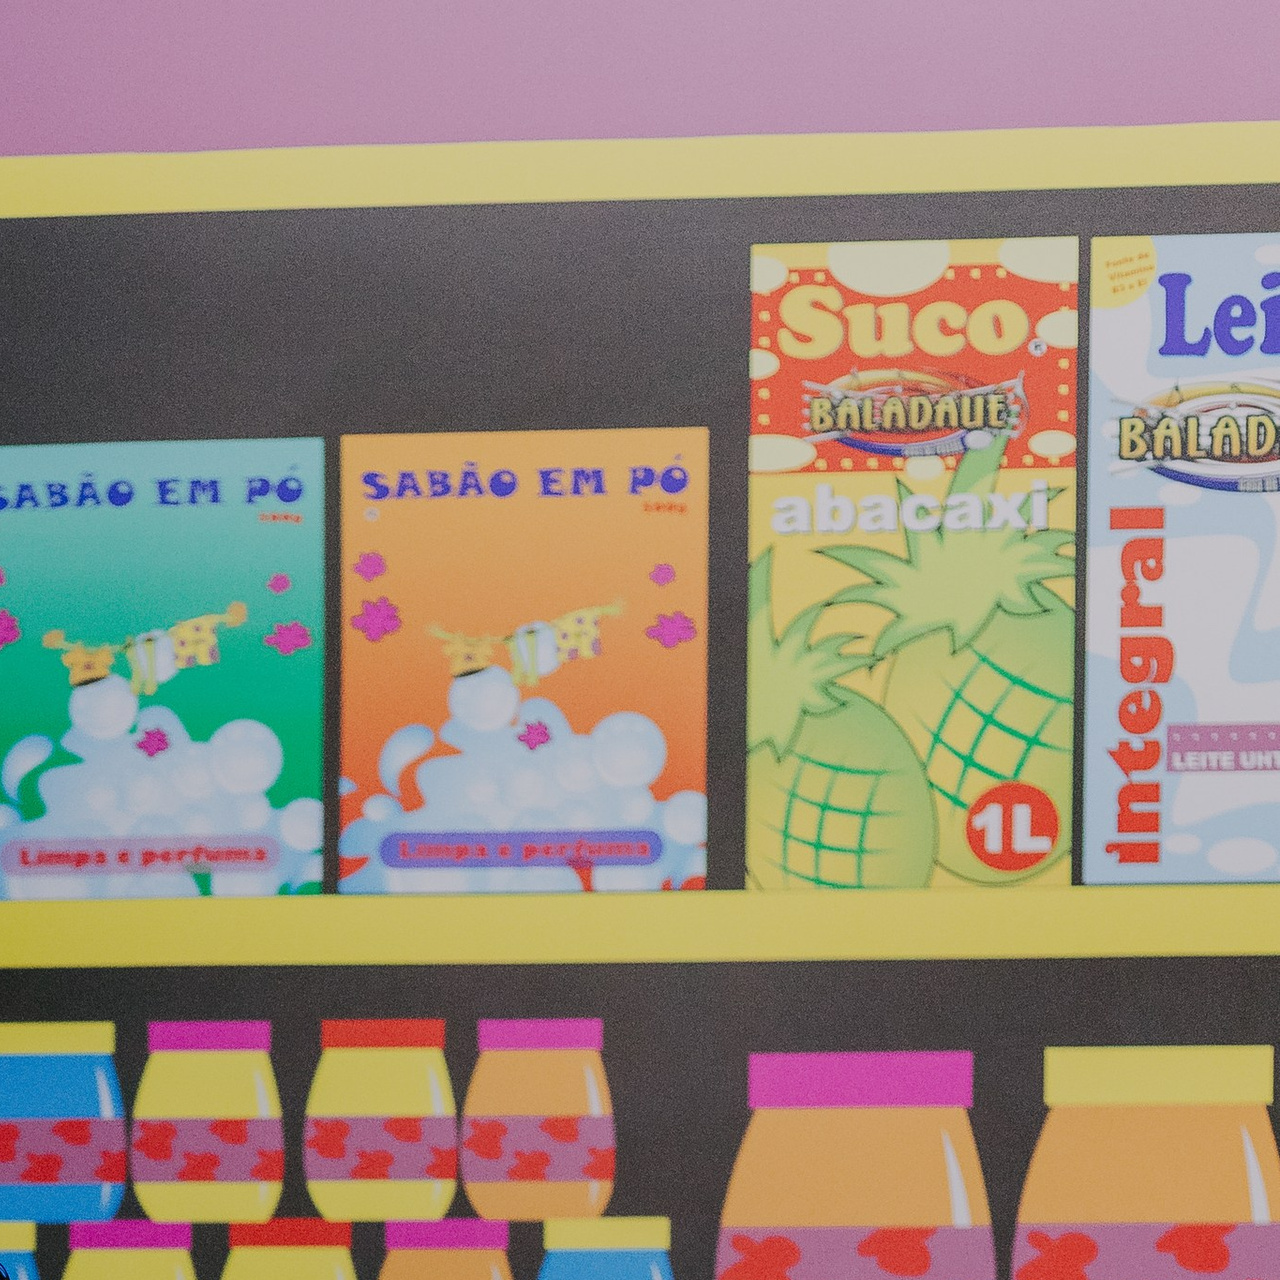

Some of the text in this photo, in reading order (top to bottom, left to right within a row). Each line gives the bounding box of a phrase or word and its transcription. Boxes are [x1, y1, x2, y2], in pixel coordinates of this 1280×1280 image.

[777, 284, 1030, 360] Suco
[157, 476, 221, 506] EM
[245, 463, 304, 504] PÓ
[361, 453, 689, 500] SABÃO EM PÓ
[770, 479, 1050, 535] abacaxi
[1171, 750, 1235, 771] LEITE
[399, 840, 488, 863] Limpa
[522, 838, 651, 862] perfuma
[972, 803, 1052, 854] 1L
[20, 847, 107, 869] Limpa
[140, 844, 266, 868] perfuma
